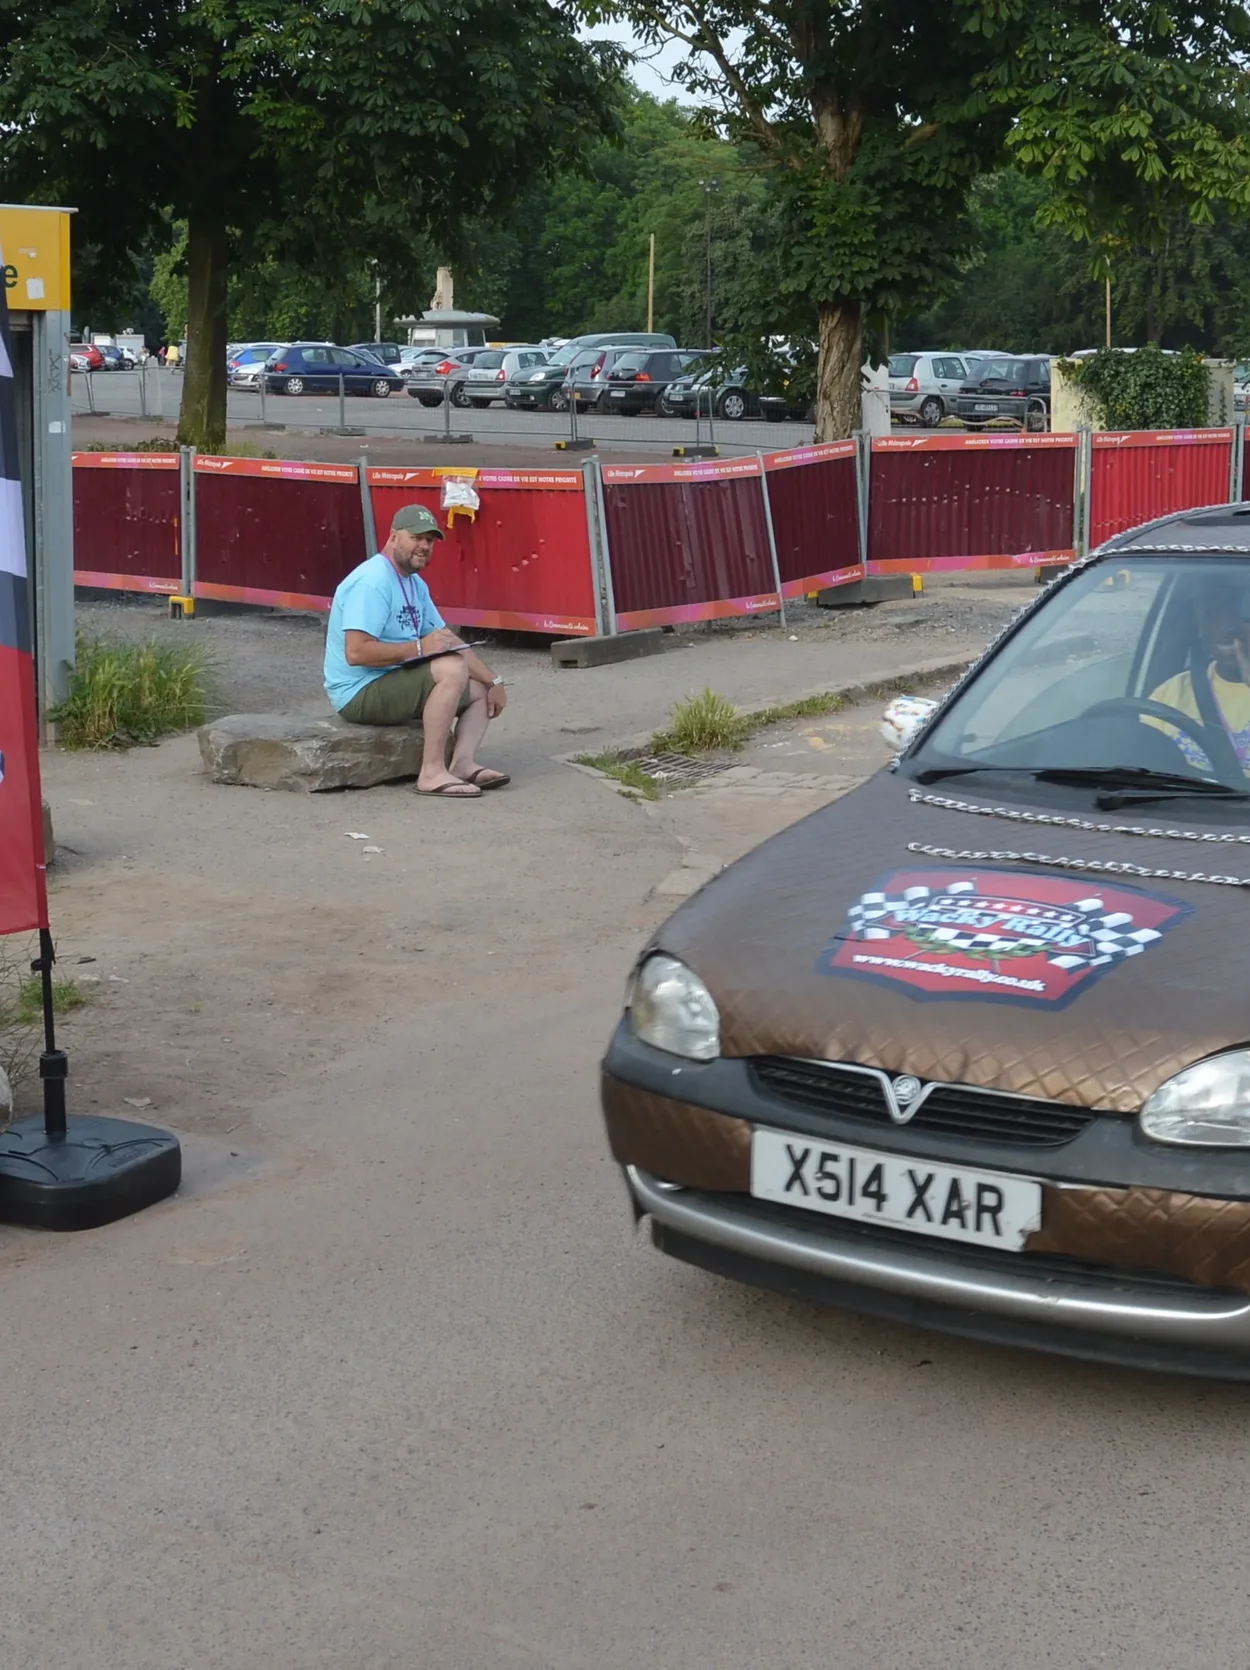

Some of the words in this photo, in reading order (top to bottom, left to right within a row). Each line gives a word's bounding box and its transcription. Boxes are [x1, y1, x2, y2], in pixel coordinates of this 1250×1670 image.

[1001, 916, 1091, 947] Rally
[783, 1143, 888, 1213] X514
[906, 1168, 1005, 1236] XAR
